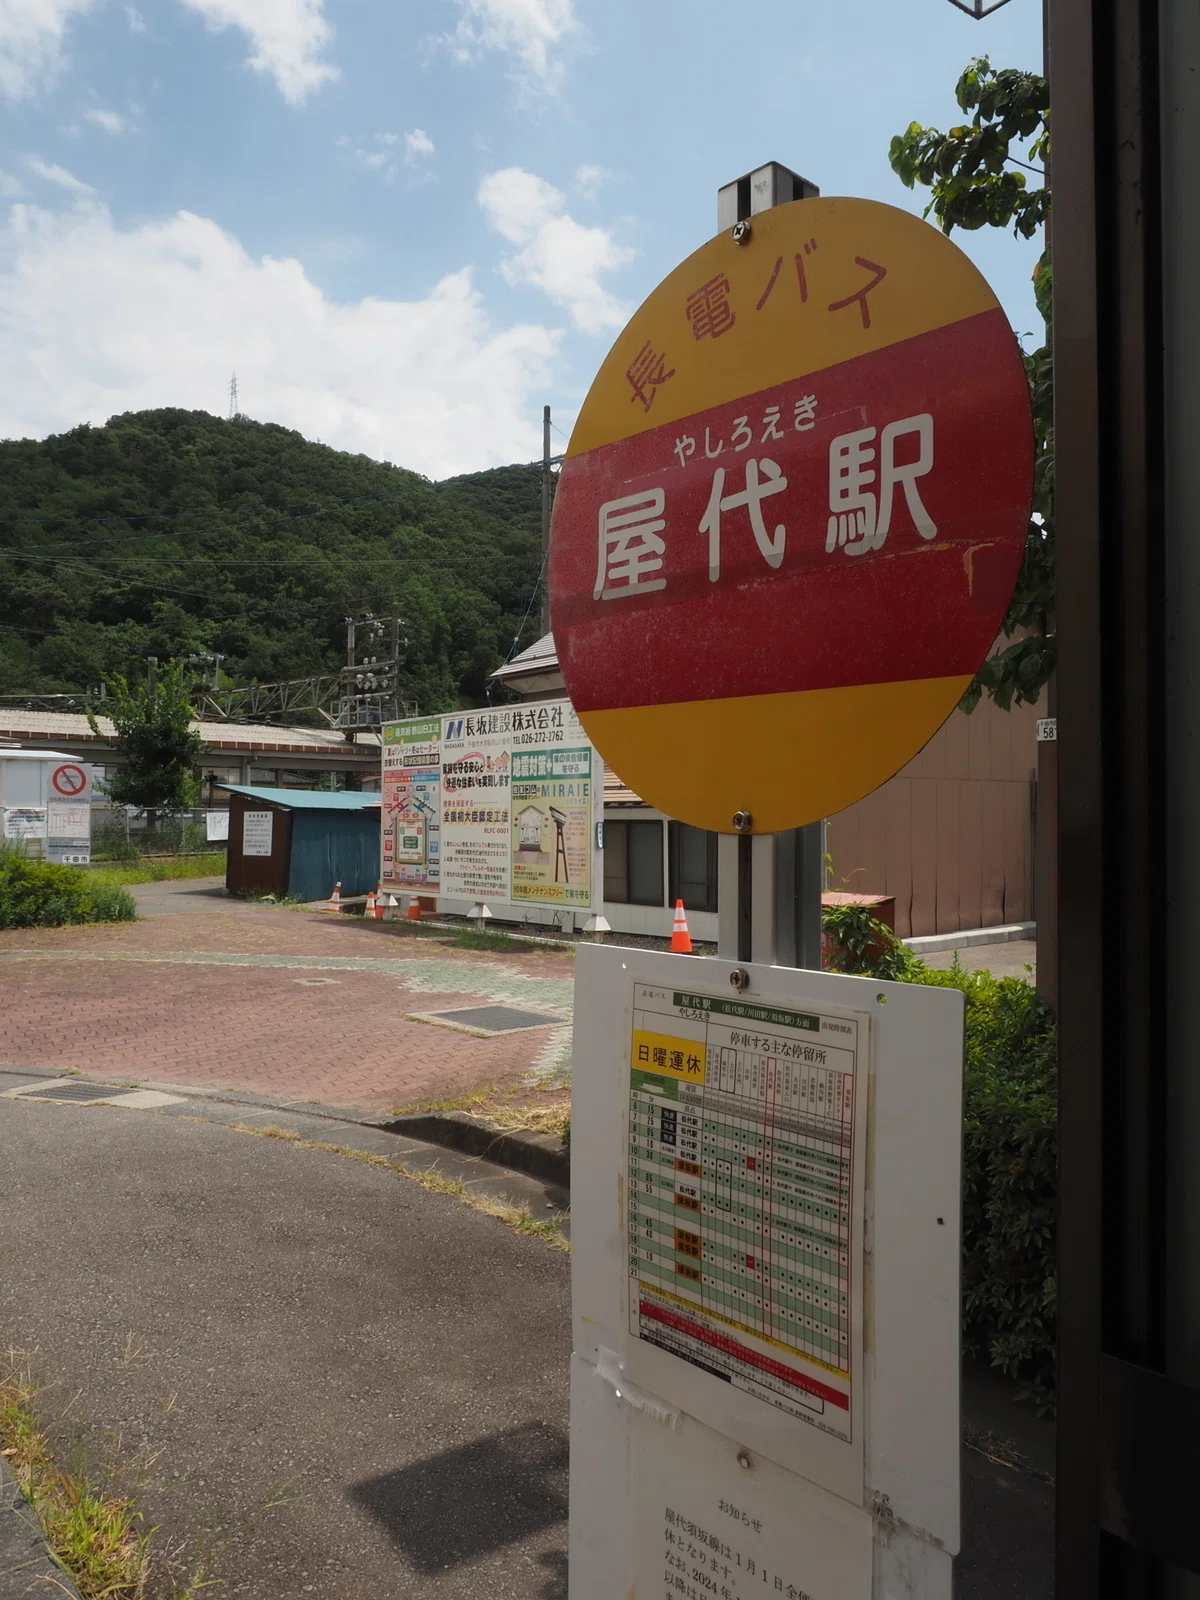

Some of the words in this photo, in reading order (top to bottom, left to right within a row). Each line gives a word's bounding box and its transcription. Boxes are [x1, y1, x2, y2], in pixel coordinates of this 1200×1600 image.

[625, 238, 887, 412] 長電バス
[674, 394, 818, 467] やしろえき
[593, 414, 937, 600] 屋代駅
[465, 706, 564, 736] 長坂建設株式会社
[521, 730, 564, 743] 026-272-2762
[1043, 727, 1054, 739] 58
[541, 783, 589, 797] MIRAIE
[443, 811, 509, 823] 全国初大臣認定工法
[681, 995, 711, 1010] 屋代駅
[679, 1008, 711, 1021] やしろえき
[730, 1031, 827, 1065] 停車する主な停留所
[638, 1044, 701, 1075] 日曜運休
[633, 1102, 638, 1110] 6
[648, 1105, 654, 1115] 15
[633, 1112, 637, 1120] 7
[647, 1116, 654, 1126] 25
[633, 1124, 637, 1132] 8
[632, 1135, 637, 1143] 9
[631, 1146, 638, 1155] 10
[631, 1157, 637, 1166] 11
[630, 1168, 637, 1177] 12
[630, 1180, 637, 1189] 13
[645, 1184, 653, 1194] 55
[630, 1190, 637, 1199] 14
[630, 1201, 637, 1211] 15
[630, 1213, 637, 1222] 16
[630, 1224, 637, 1233] 17
[630, 1235, 637, 1244] 18
[630, 1245, 637, 1255] 19
[630, 1257, 637, 1266] 20
[630, 1267, 637, 1277] 21
[717, 1498, 763, 1534] お知らせ
[664, 1528, 736, 1586] 休となります。
